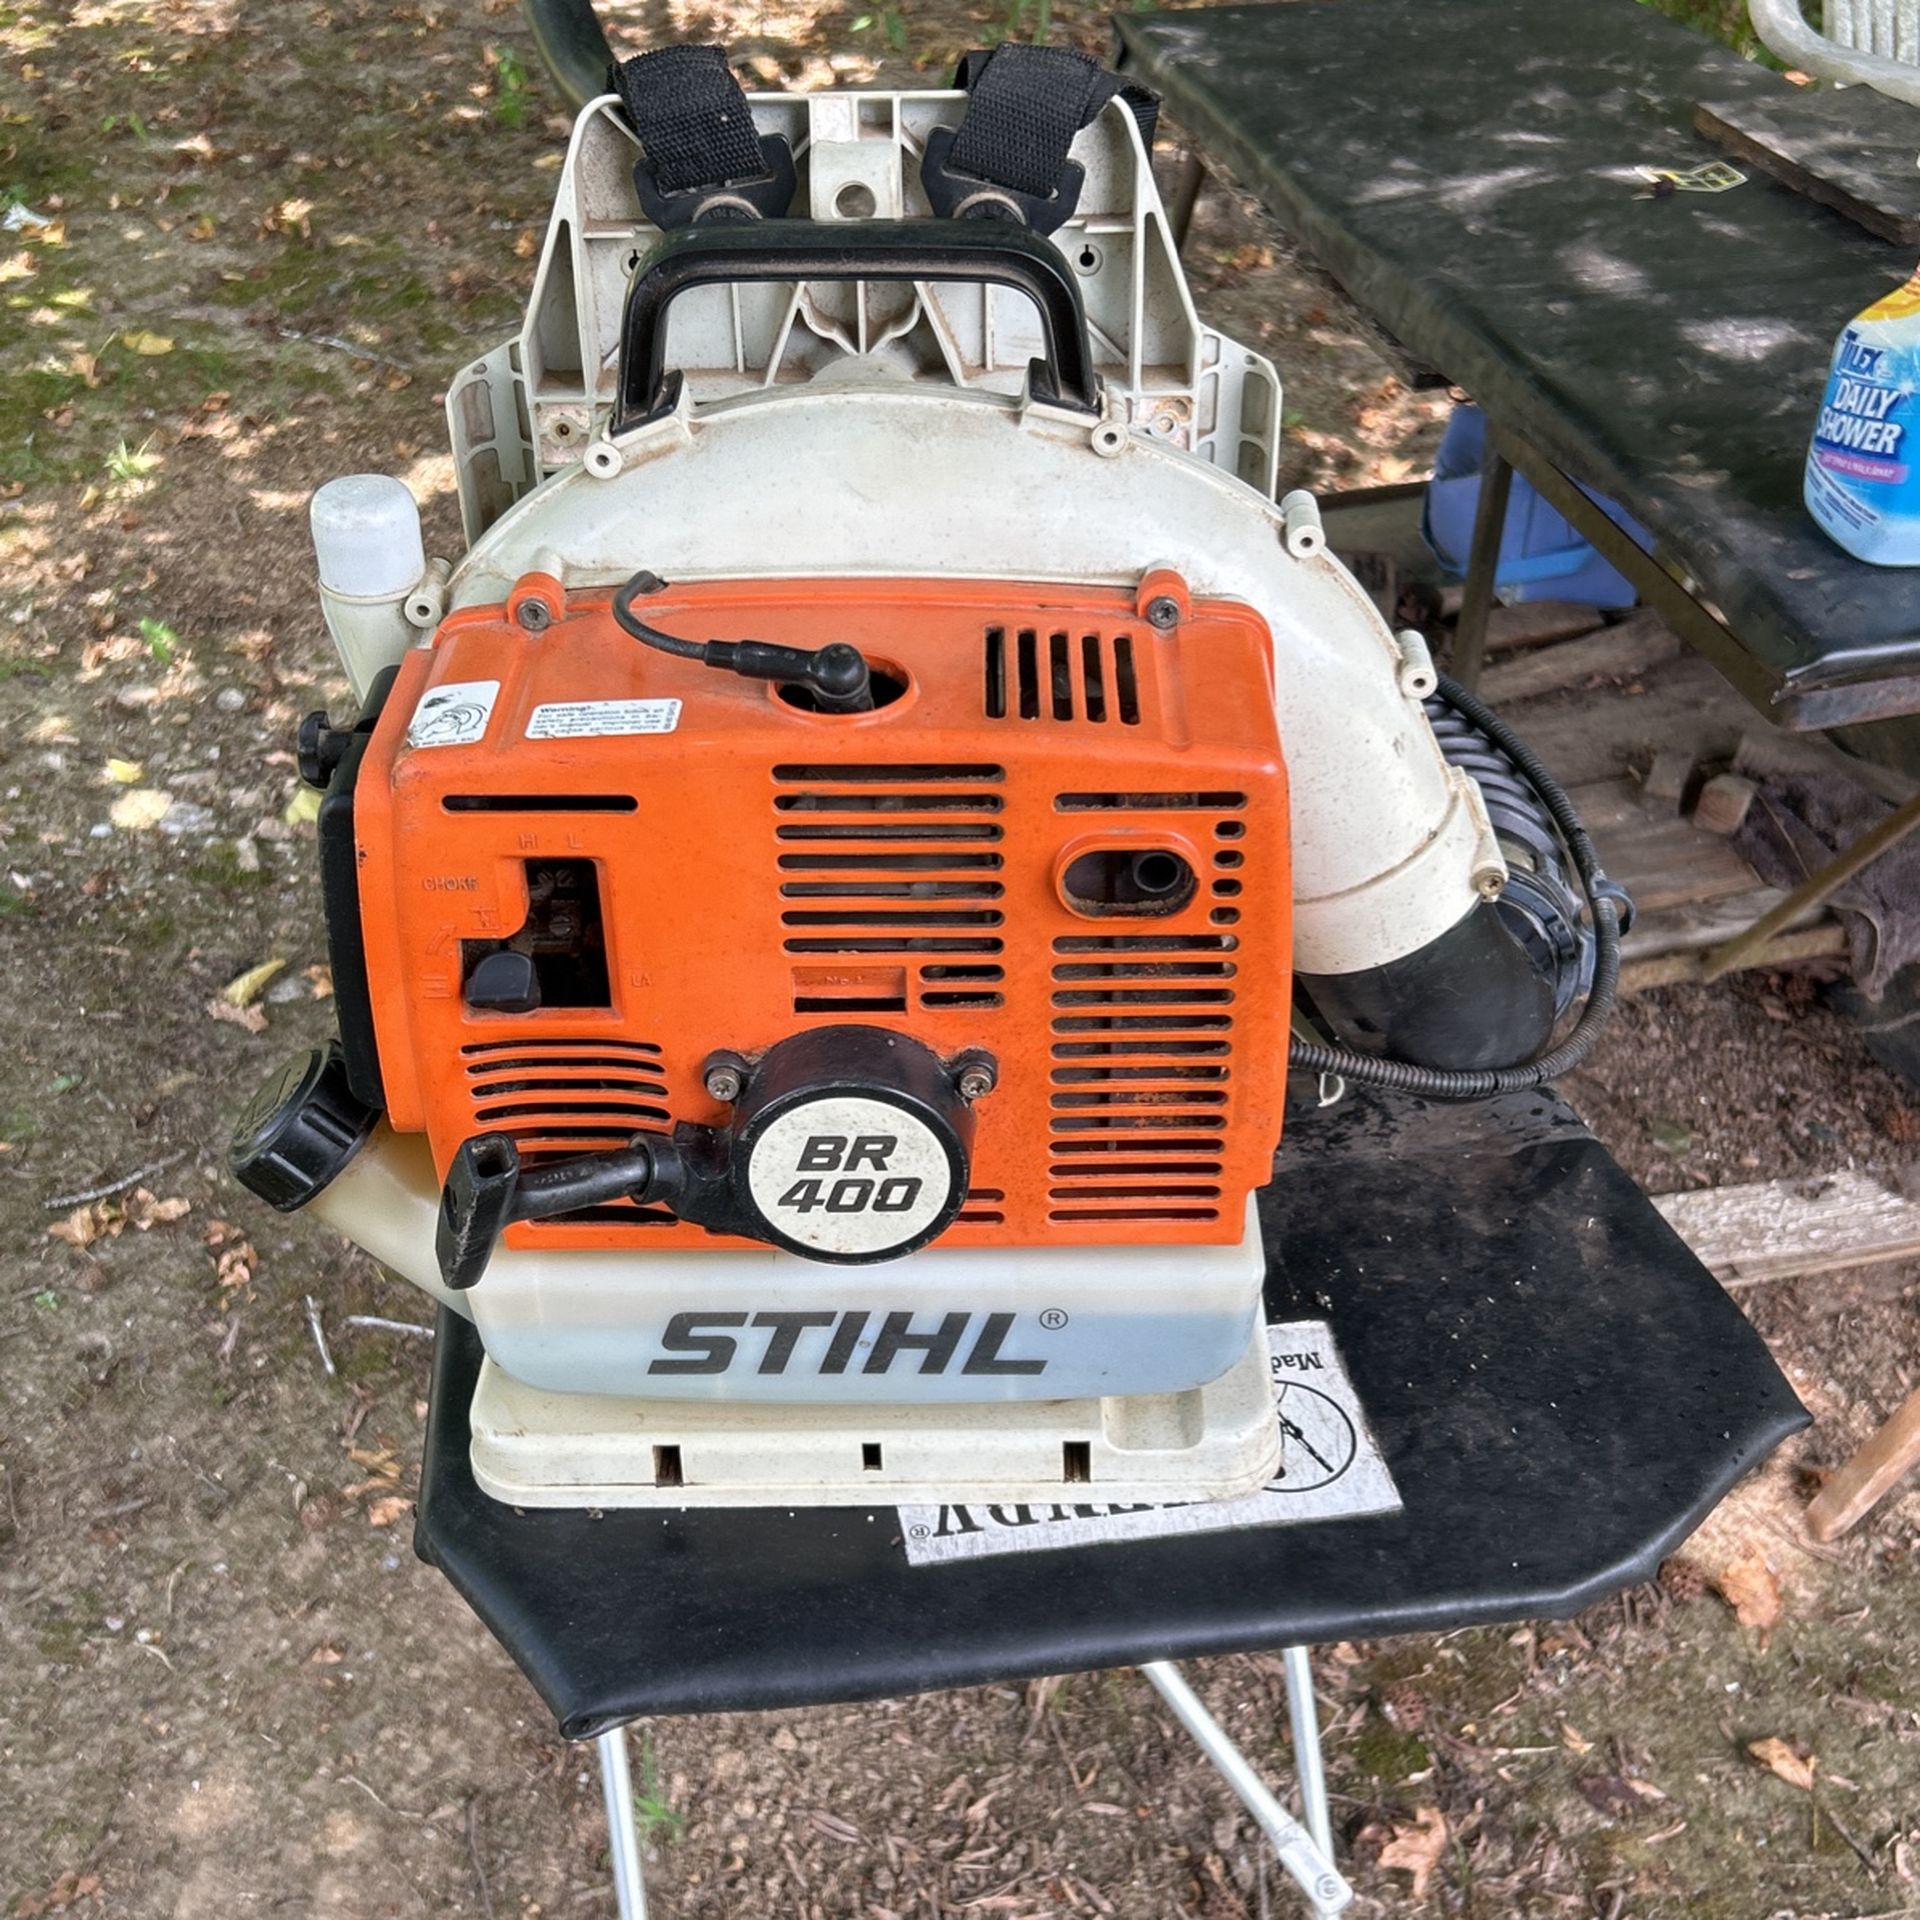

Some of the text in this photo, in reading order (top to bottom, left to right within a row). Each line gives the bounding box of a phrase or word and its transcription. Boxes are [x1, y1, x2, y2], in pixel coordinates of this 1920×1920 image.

[1833, 379, 1900, 419] DAILY
[1817, 407, 1902, 454] SHOWER
[519, 833, 583, 849] H L
[423, 876, 478, 890] CHOKE
[796, 1135, 898, 1172] BR
[777, 1177, 923, 1213] 400
[647, 1311, 1048, 1375] STIHL
